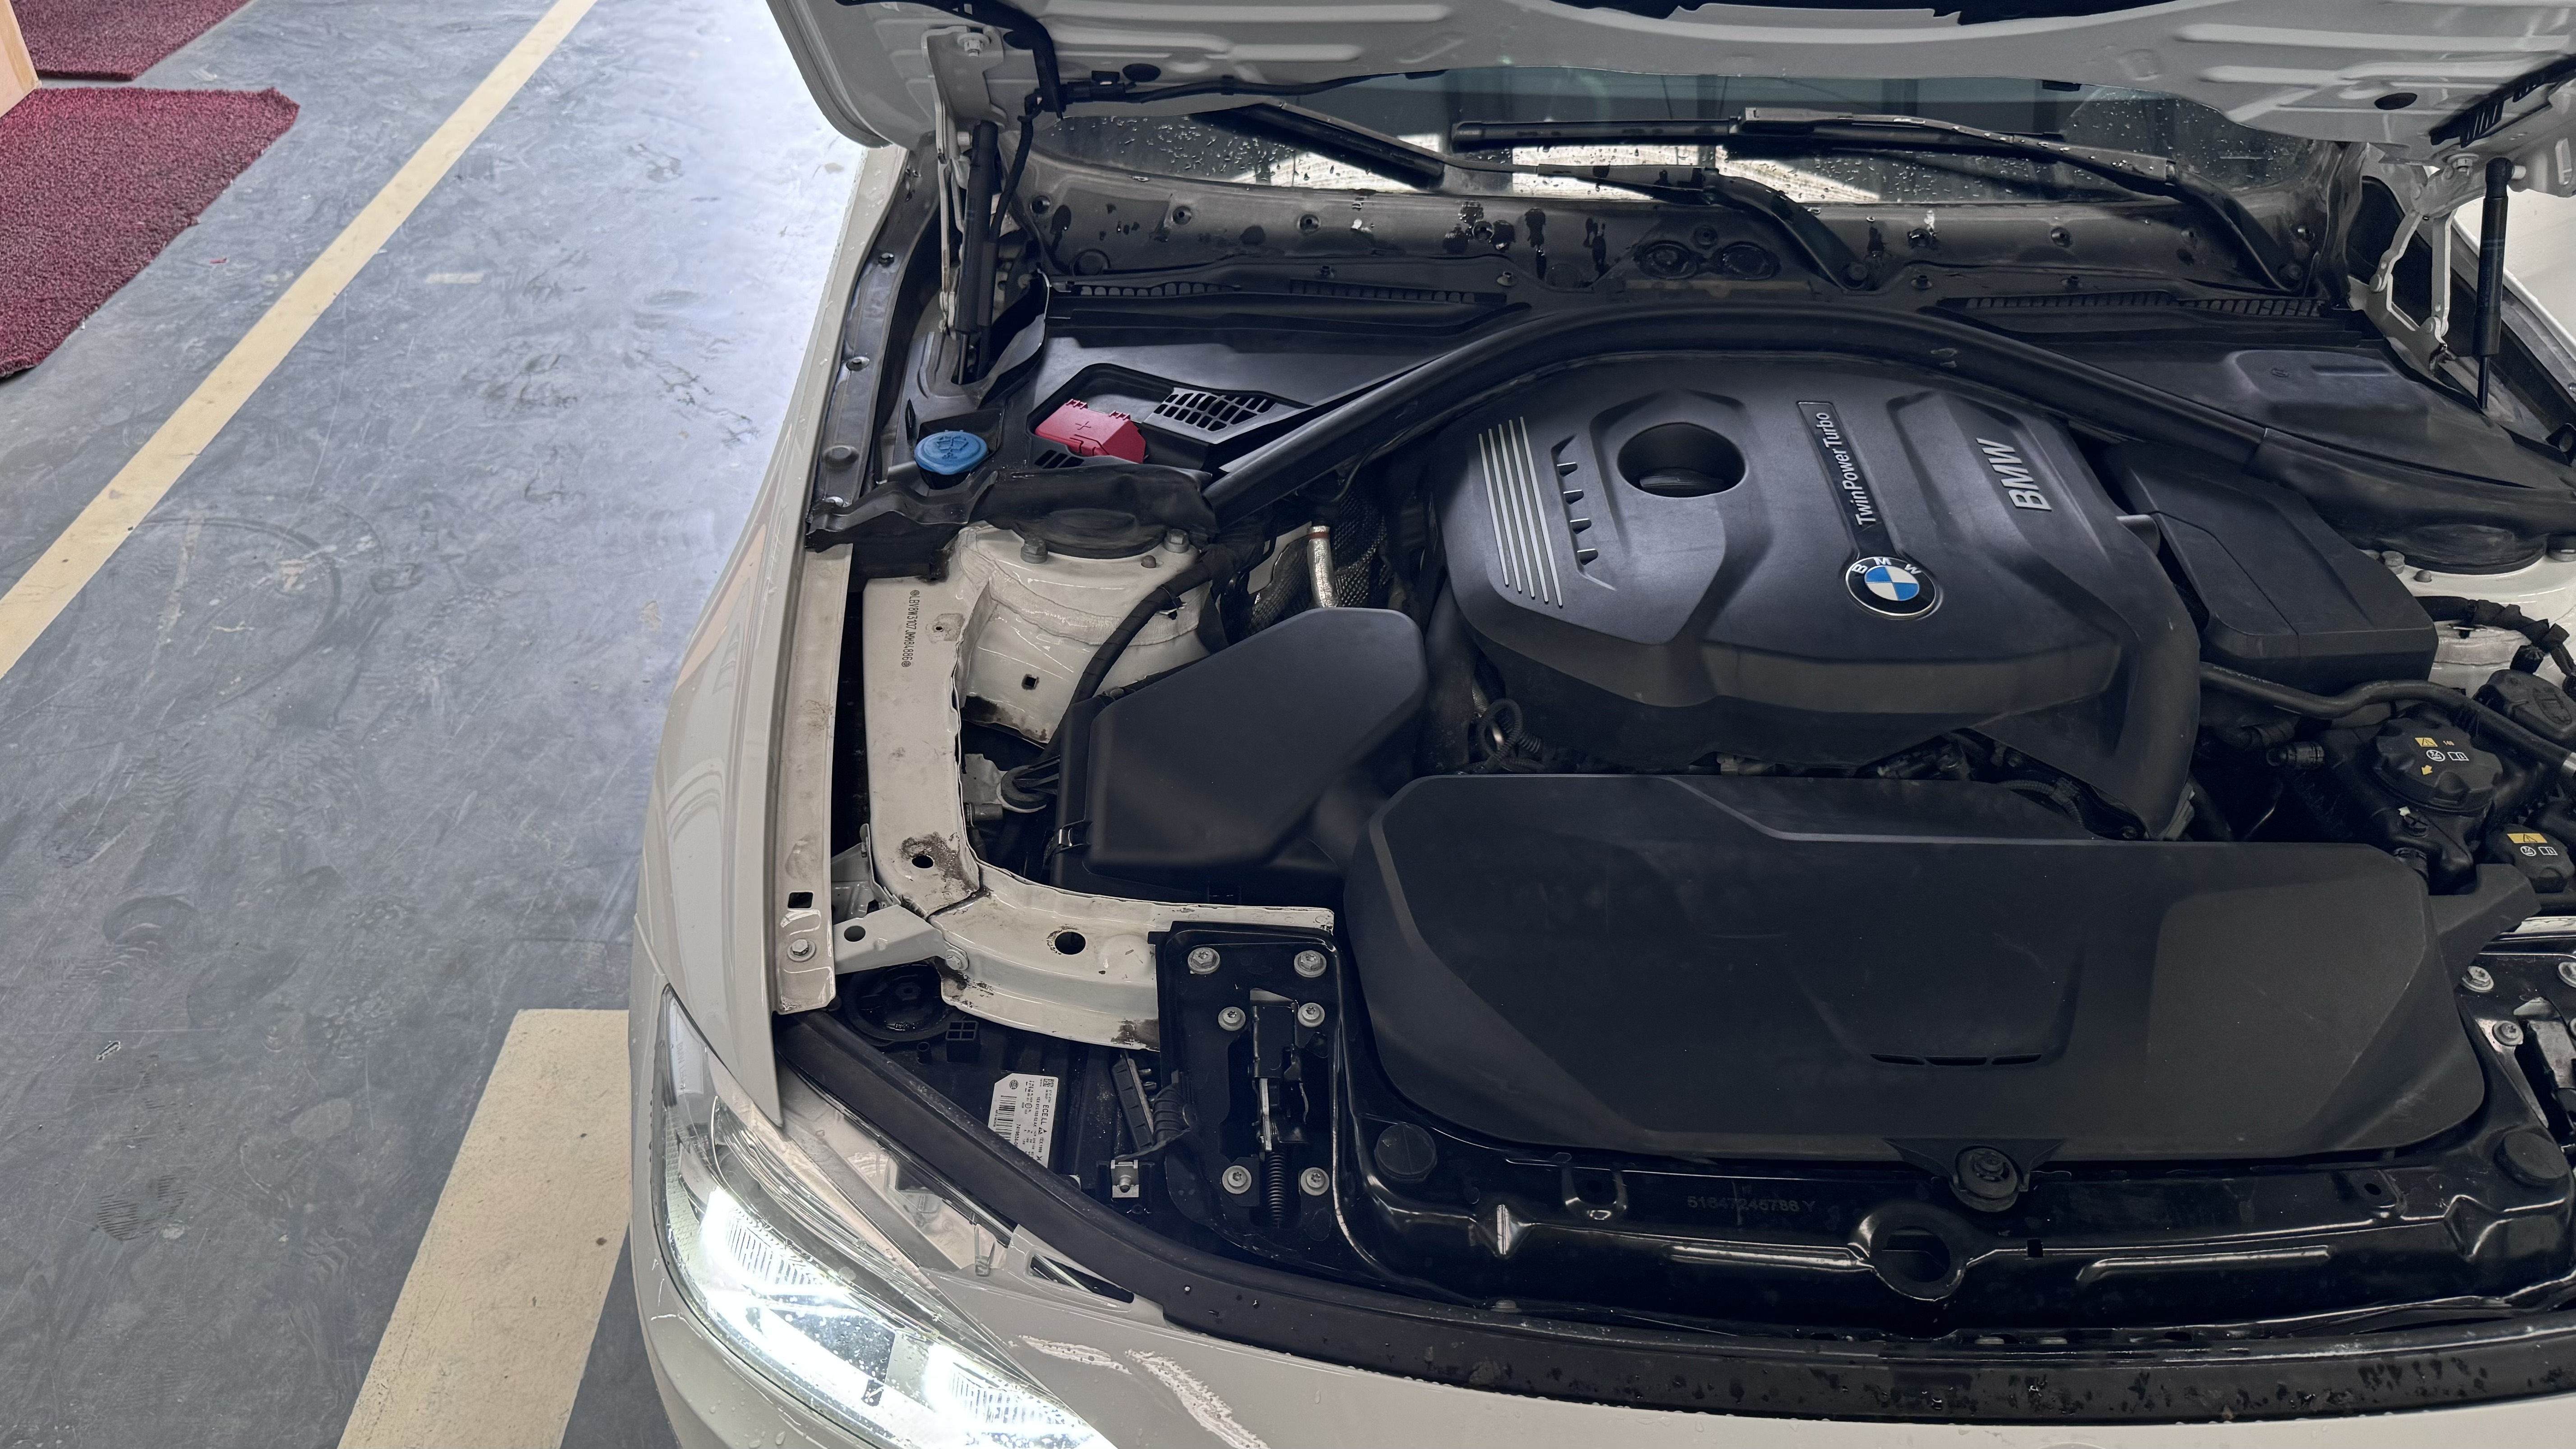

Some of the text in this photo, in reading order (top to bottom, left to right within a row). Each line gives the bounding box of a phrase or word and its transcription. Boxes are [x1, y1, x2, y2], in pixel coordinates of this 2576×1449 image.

[1976, 438, 2052, 512] BMW
[1851, 557, 1922, 575] BMW
[676, 1041, 685, 1064] BMW
[1802, 1200, 1816, 1213] Y
